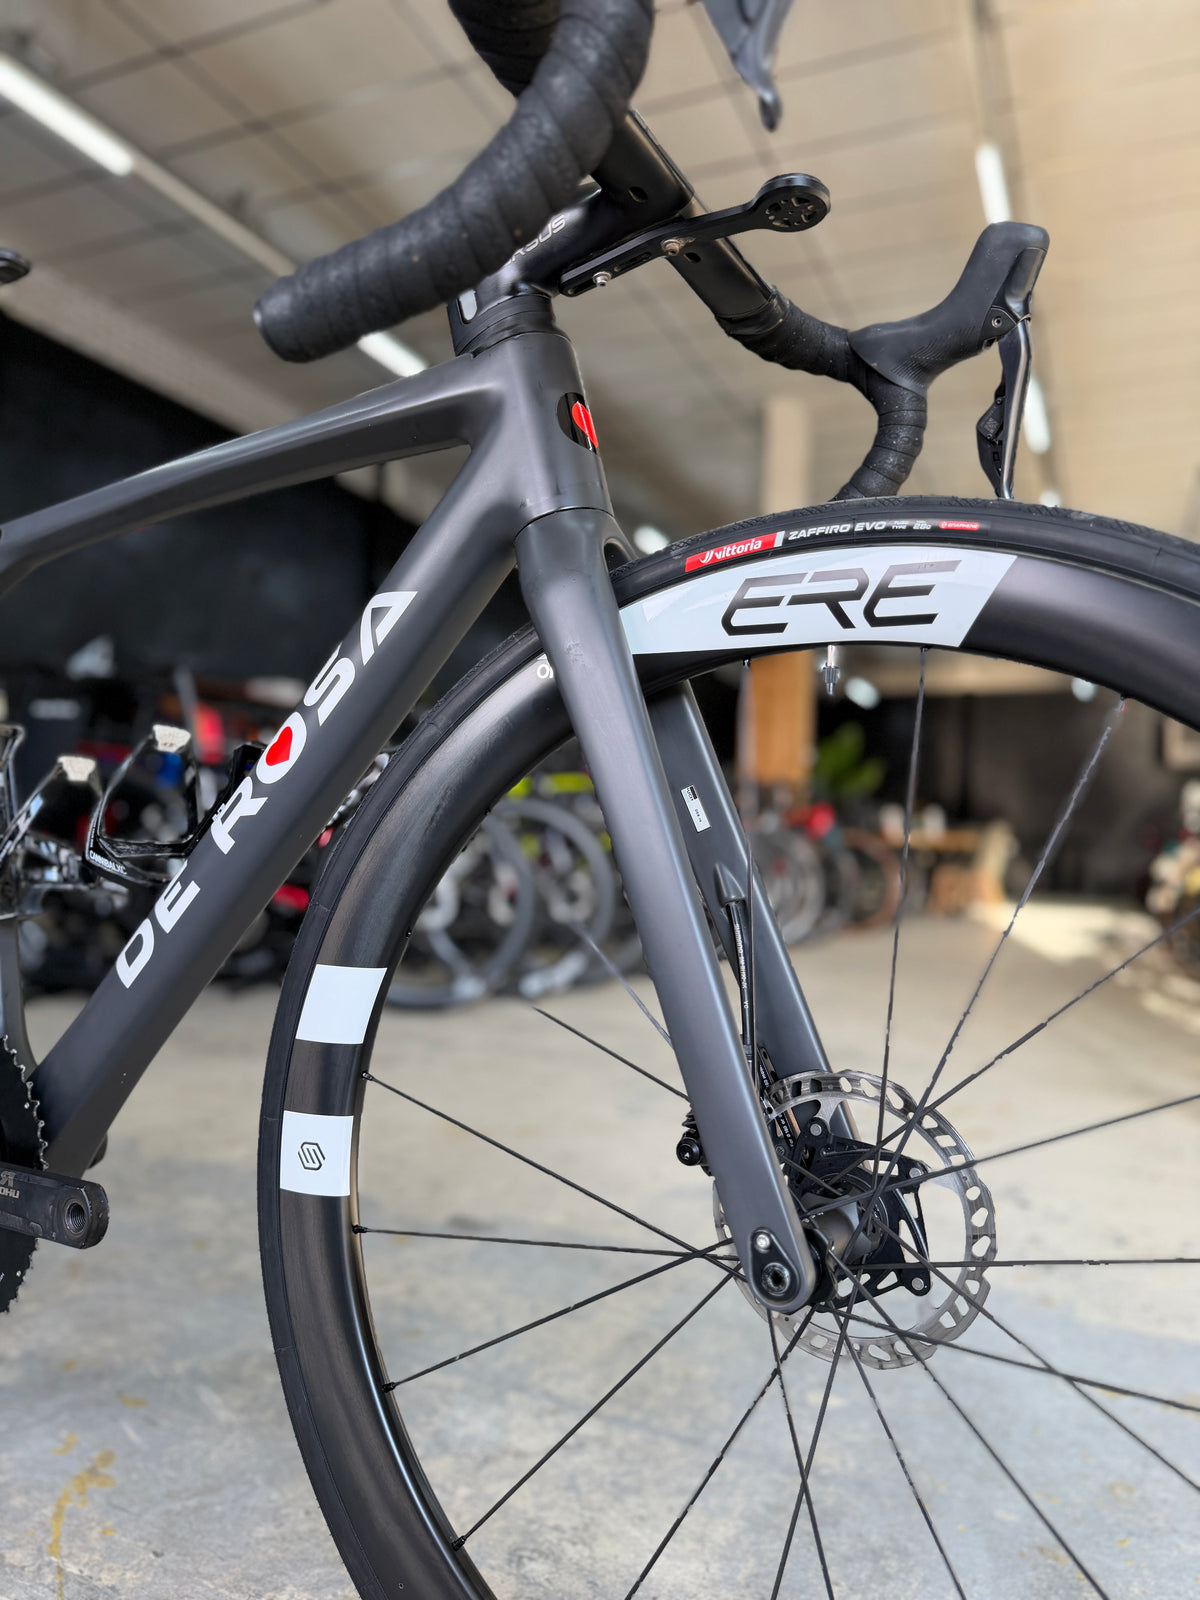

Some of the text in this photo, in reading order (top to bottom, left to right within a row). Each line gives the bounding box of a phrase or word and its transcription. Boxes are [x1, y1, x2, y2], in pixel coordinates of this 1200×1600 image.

[713, 539, 762, 560] vittoria
[788, 520, 887, 541] ZAFFIRO EVO
[721, 559, 962, 636] ERE
[115, 590, 419, 989] DE ROSA
